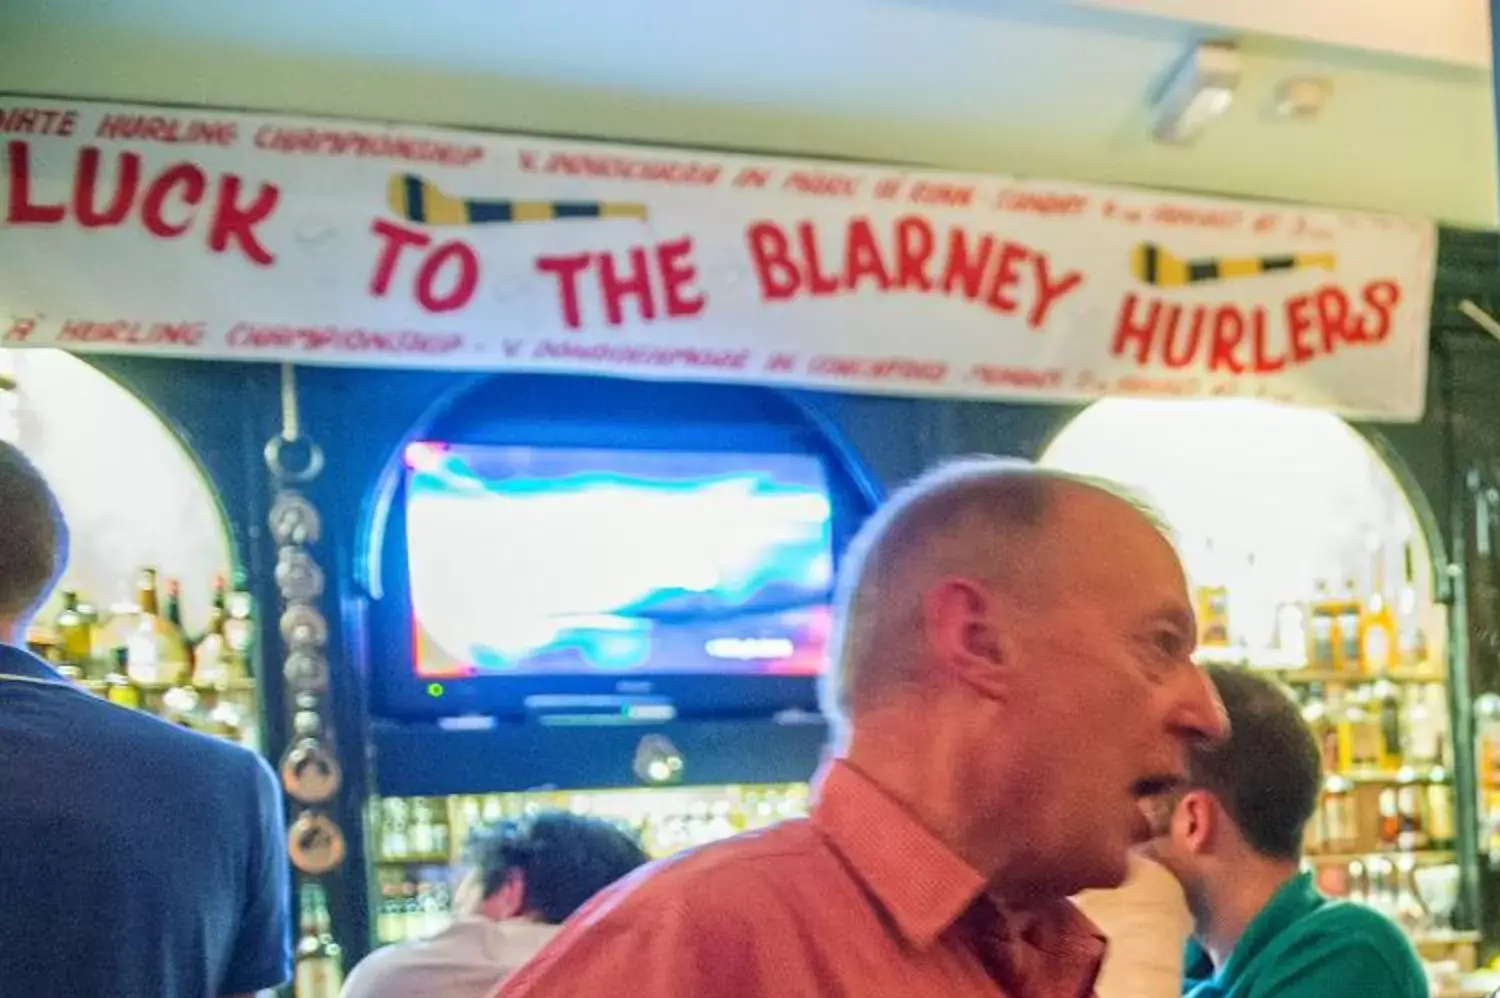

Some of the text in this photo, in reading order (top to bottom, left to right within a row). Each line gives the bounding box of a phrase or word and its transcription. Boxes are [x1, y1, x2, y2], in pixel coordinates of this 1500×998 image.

[96, 113, 238, 146] HURLING
[7, 140, 1403, 375] LUCK TO THE BLARNEY HURLERS
[57, 320, 205, 345] HURLING
